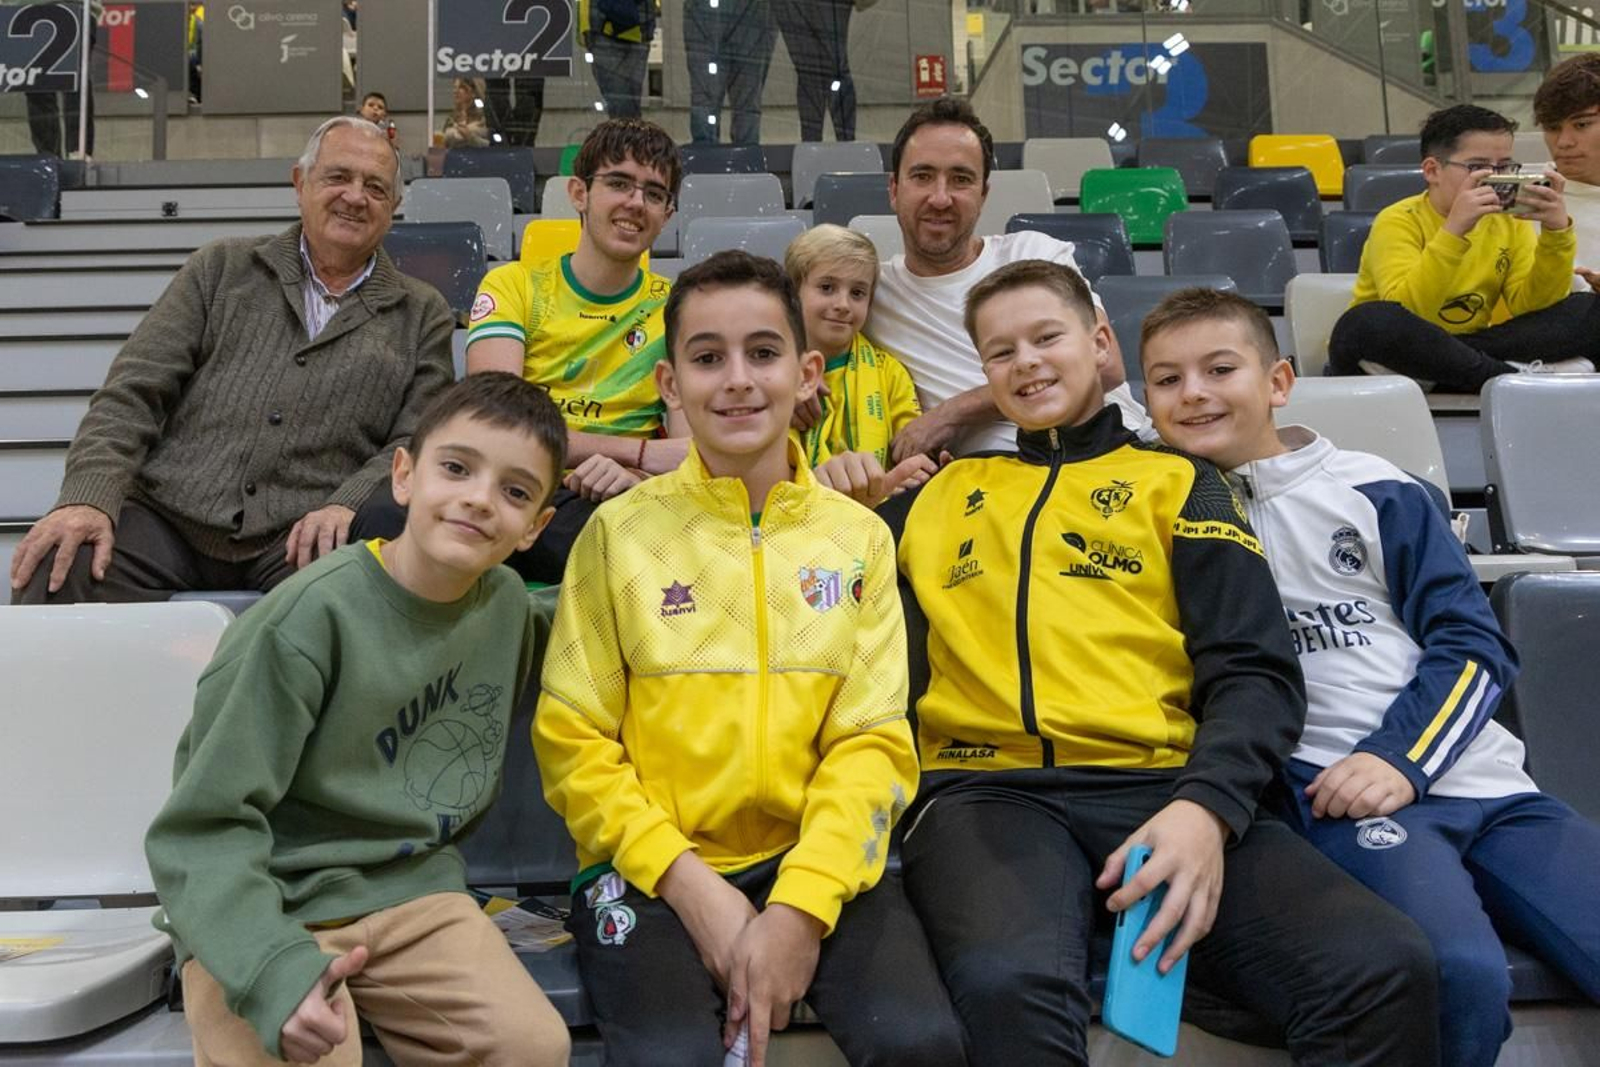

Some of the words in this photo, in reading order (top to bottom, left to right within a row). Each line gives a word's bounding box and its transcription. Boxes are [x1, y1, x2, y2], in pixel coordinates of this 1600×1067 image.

[8, 2, 78, 91] 2
[503, 0, 572, 77] 2
[436, 47, 538, 73] Sector
[1022, 45, 1179, 86] Sector
[1202, 525, 1222, 535] JPI
[1088, 551, 1143, 575] OLMO
[375, 660, 462, 768] DUNK
